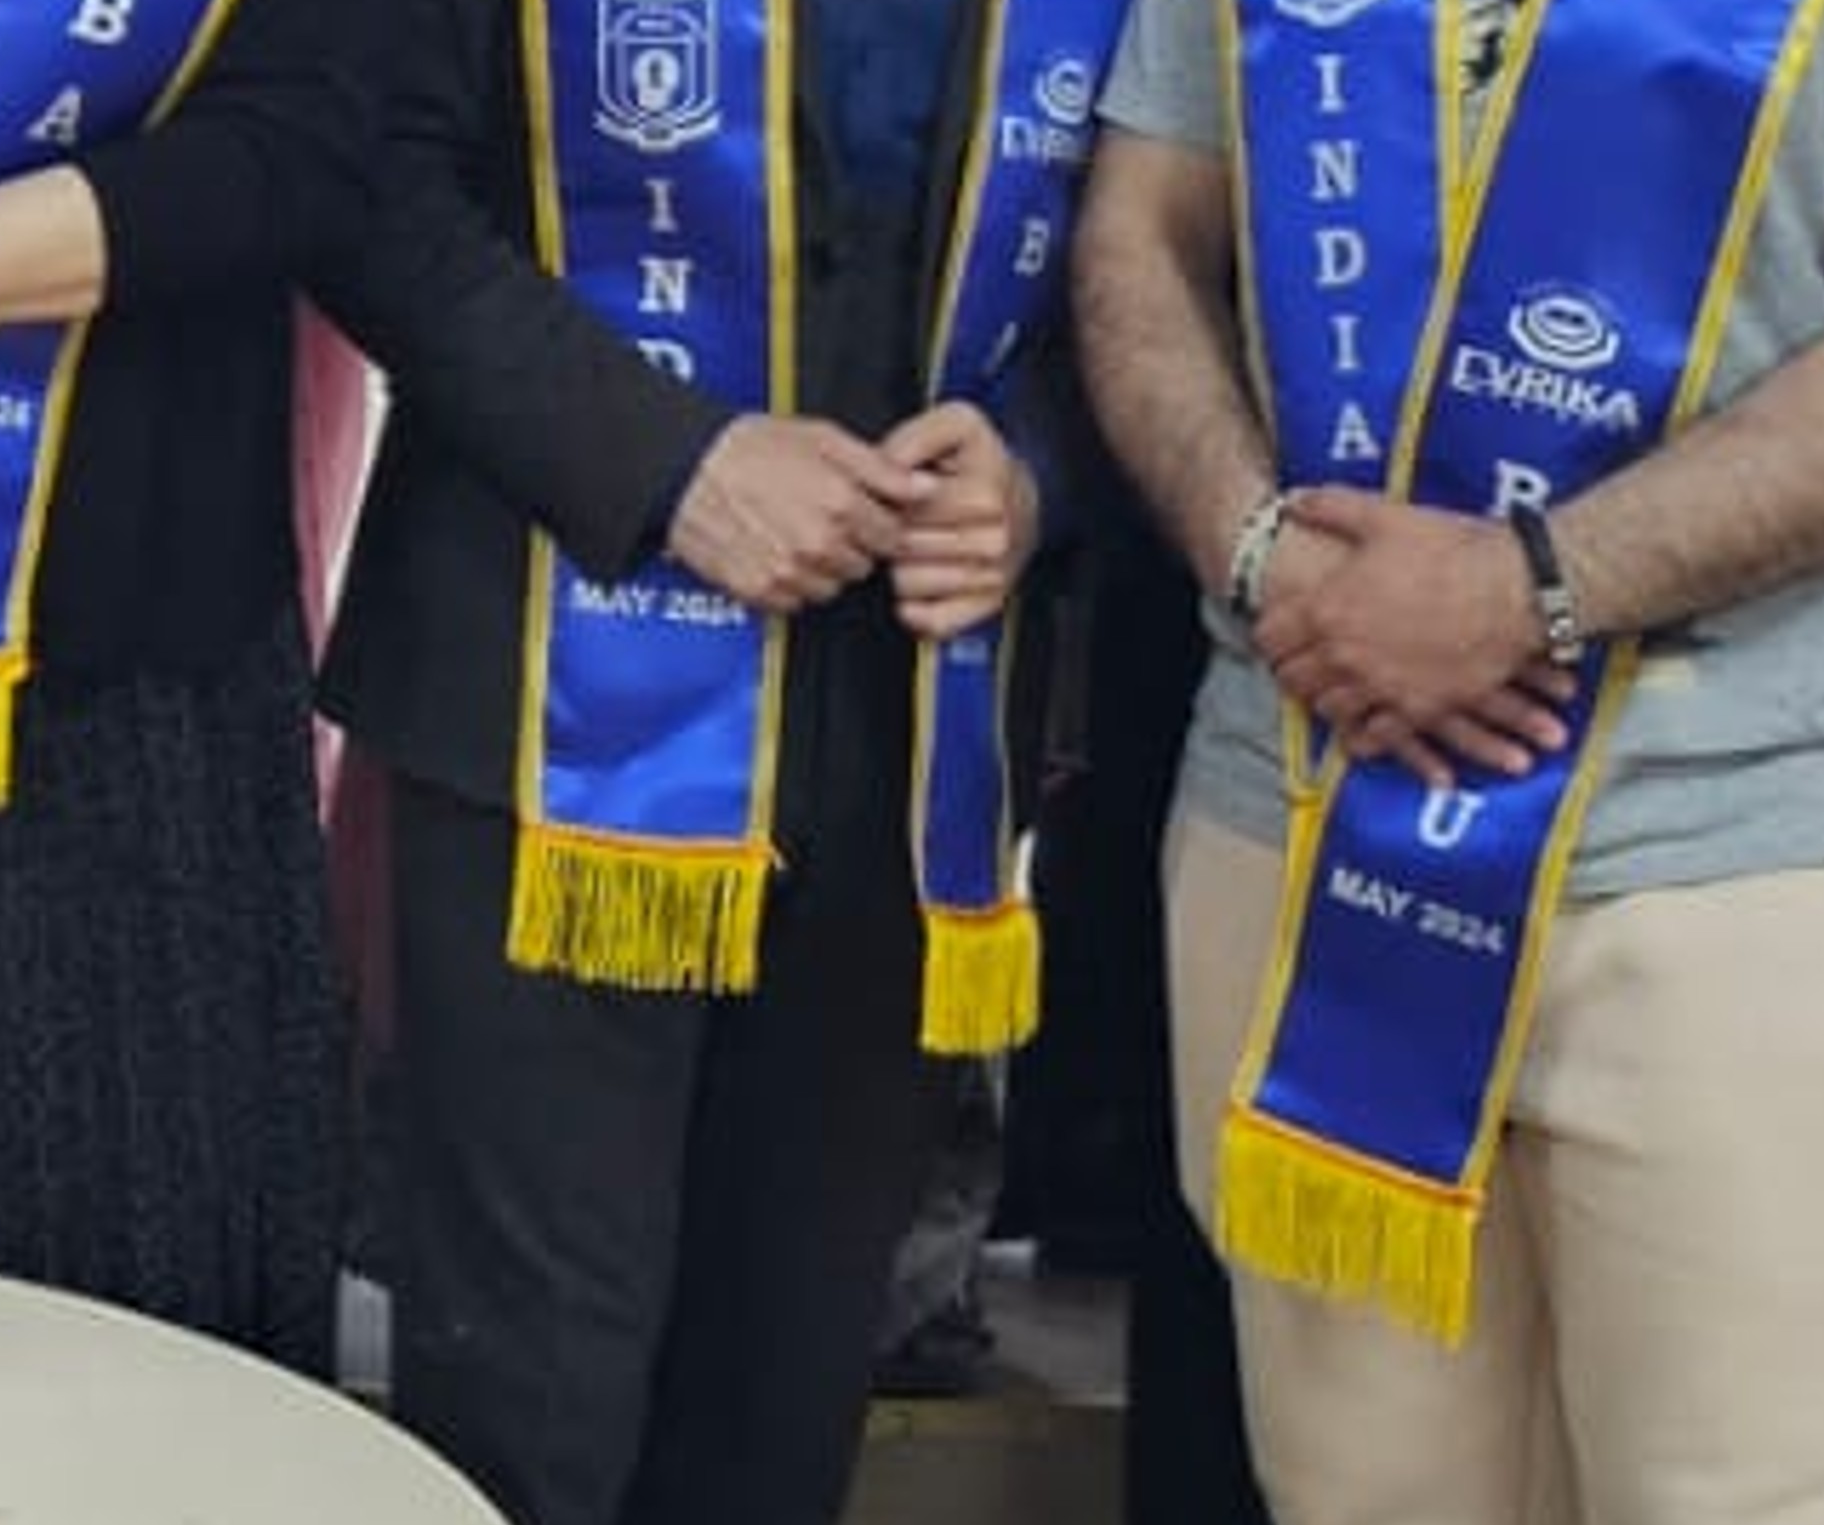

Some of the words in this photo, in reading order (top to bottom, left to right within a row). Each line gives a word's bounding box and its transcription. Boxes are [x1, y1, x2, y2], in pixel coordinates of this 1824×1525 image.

[1310, 56, 1378, 460] INDIA
[571, 579, 657, 617] MAY
[1330, 867, 1412, 922] MAY
